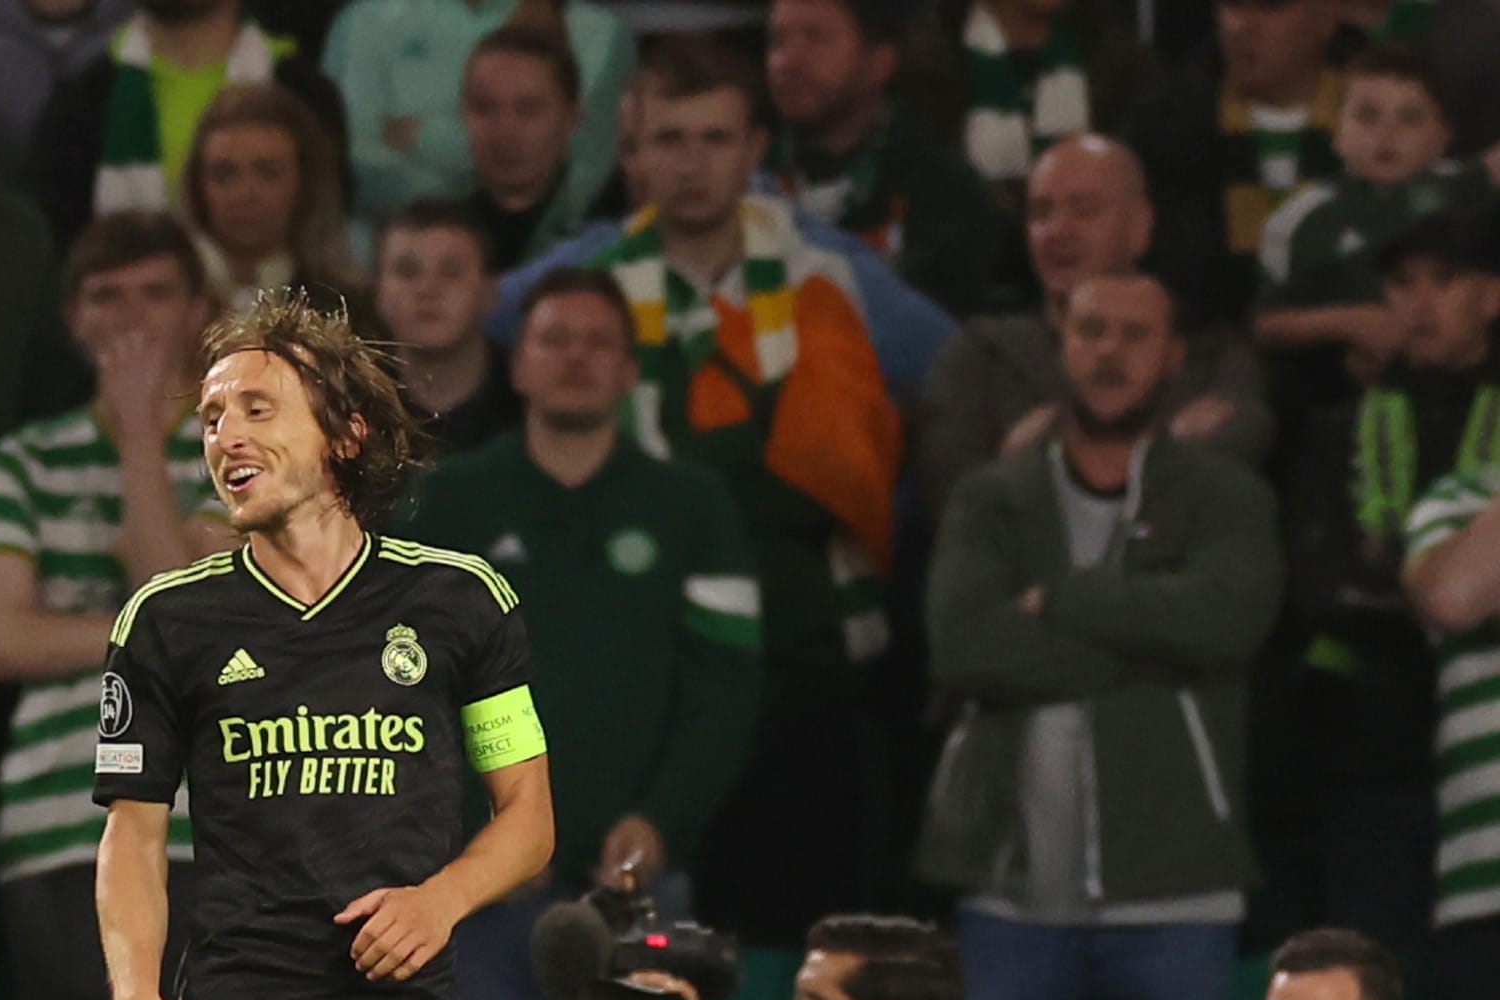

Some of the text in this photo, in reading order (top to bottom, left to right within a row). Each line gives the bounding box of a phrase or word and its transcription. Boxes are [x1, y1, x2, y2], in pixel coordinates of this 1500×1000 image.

[218, 667, 266, 685] adidas
[218, 705, 425, 763] Emirates
[249, 757, 396, 799] FLY BETTER
